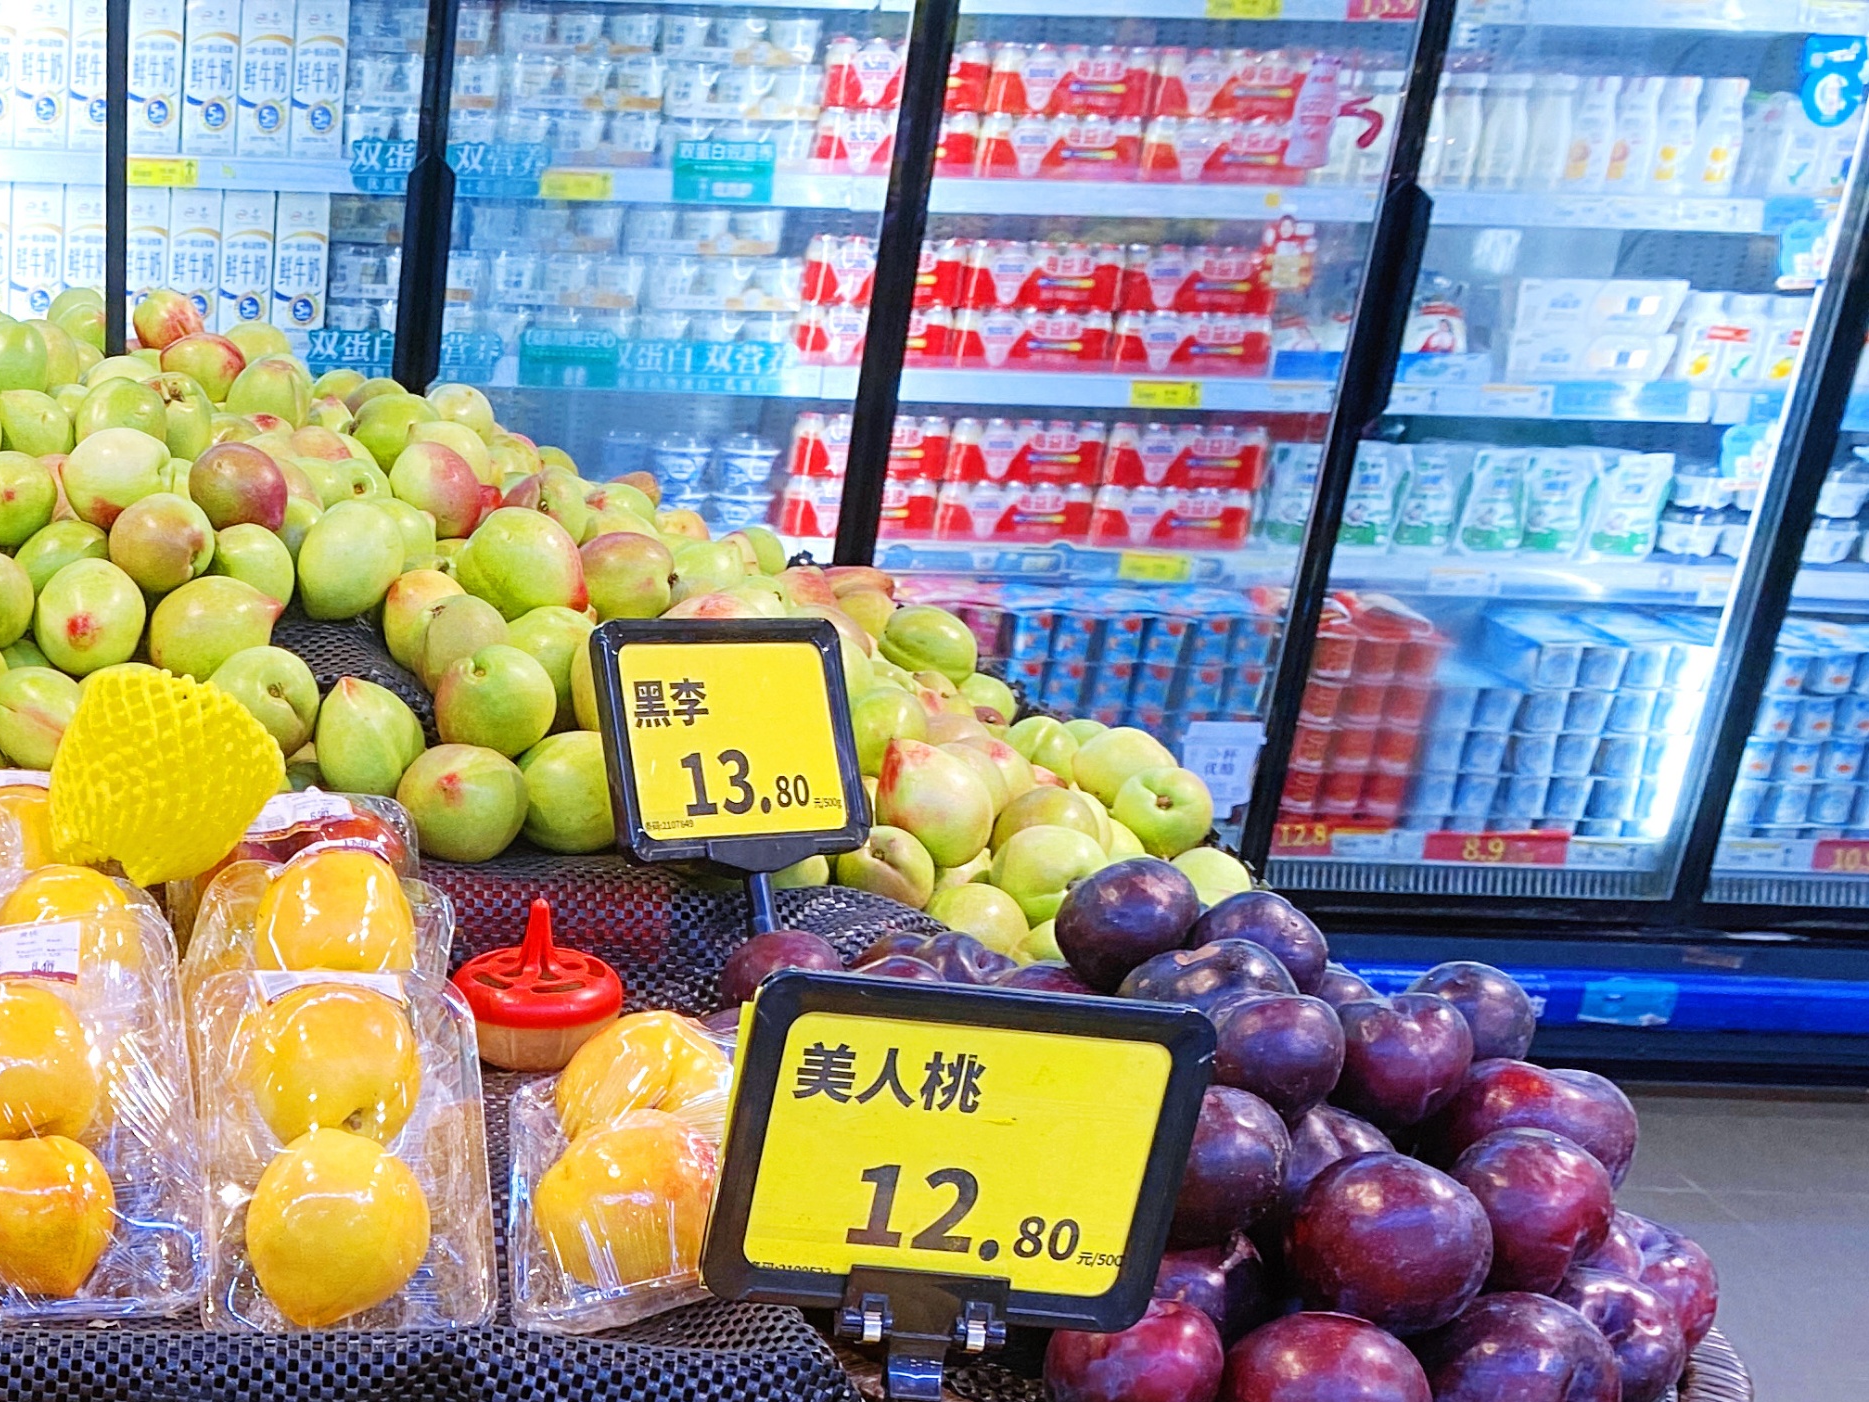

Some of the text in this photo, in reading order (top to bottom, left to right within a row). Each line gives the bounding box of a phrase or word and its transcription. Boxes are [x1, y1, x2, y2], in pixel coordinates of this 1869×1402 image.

[74, 53, 106, 86] 鲜牛
[190, 57, 233, 90] 鲜牛奶
[243, 60, 287, 94] 鲜牛奶
[296, 61, 340, 94] 鲜牛奶
[174, 252, 216, 286] 鲜牛奶
[224, 253, 268, 287] 鲜牛奶
[278, 255, 320, 288] 鲜牛奶
[632, 678, 710, 729] 黑李
[679, 748, 843, 817] 13.80 元/500g
[1279, 823, 1328, 848] 12.8
[1462, 836, 1504, 862] 8.9
[792, 1040, 987, 1114] 美人桃
[845, 1163, 1080, 1263] 12.80
